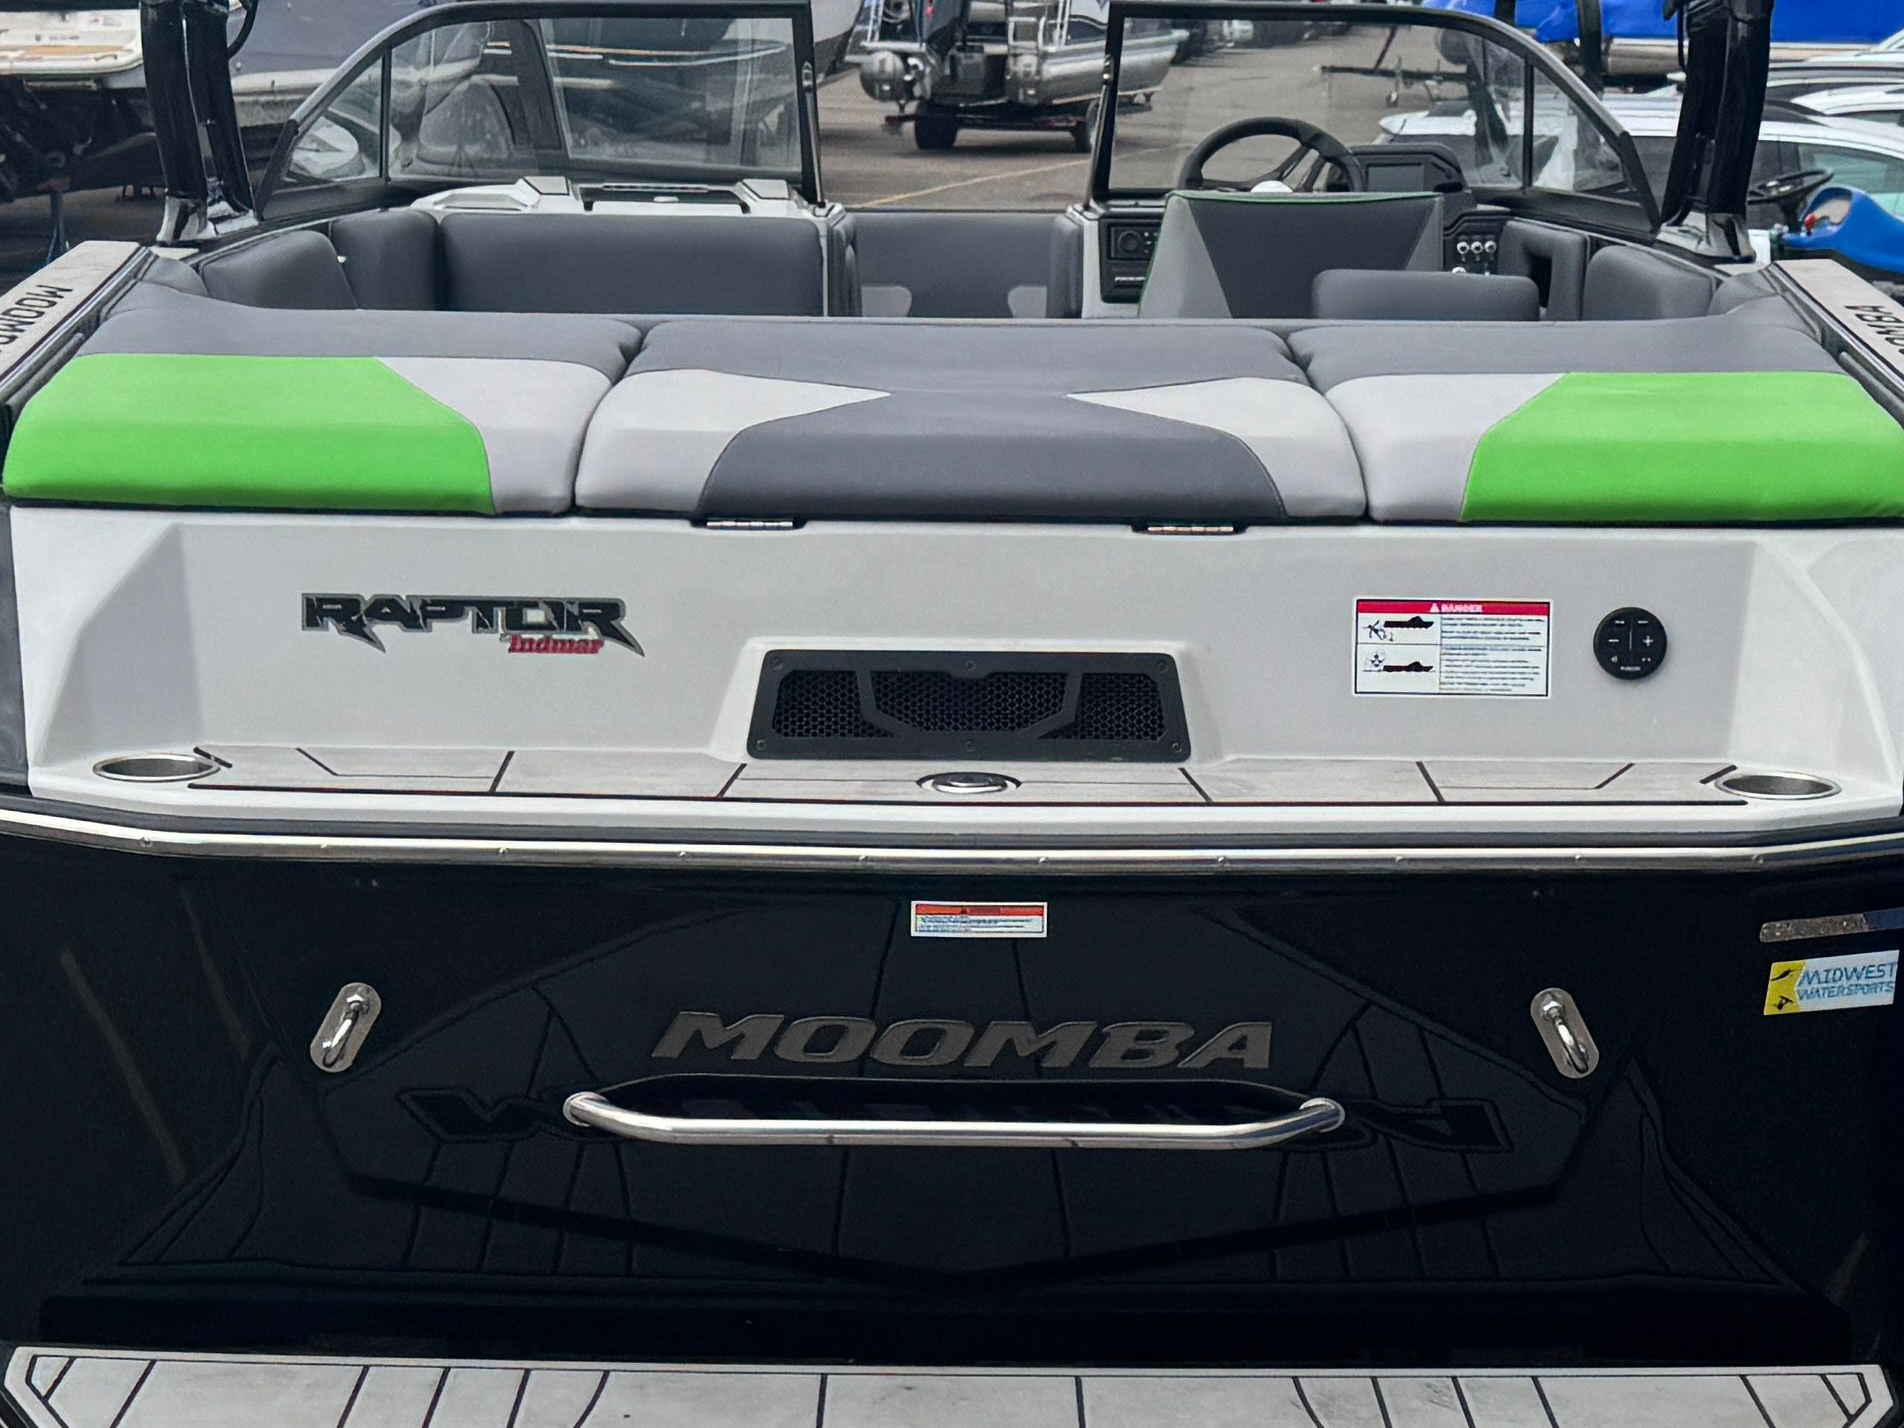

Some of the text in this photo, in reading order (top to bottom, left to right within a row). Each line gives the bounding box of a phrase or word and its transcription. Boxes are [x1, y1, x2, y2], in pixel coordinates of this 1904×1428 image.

[1441, 604, 1483, 613] DANGER
[302, 593, 645, 657] RAPTOR
[1798, 962, 1898, 986] MIDWEST
[1798, 981, 1895, 1001] WATERSPORTS
[652, 1011, 1273, 1069] MOOMBA
